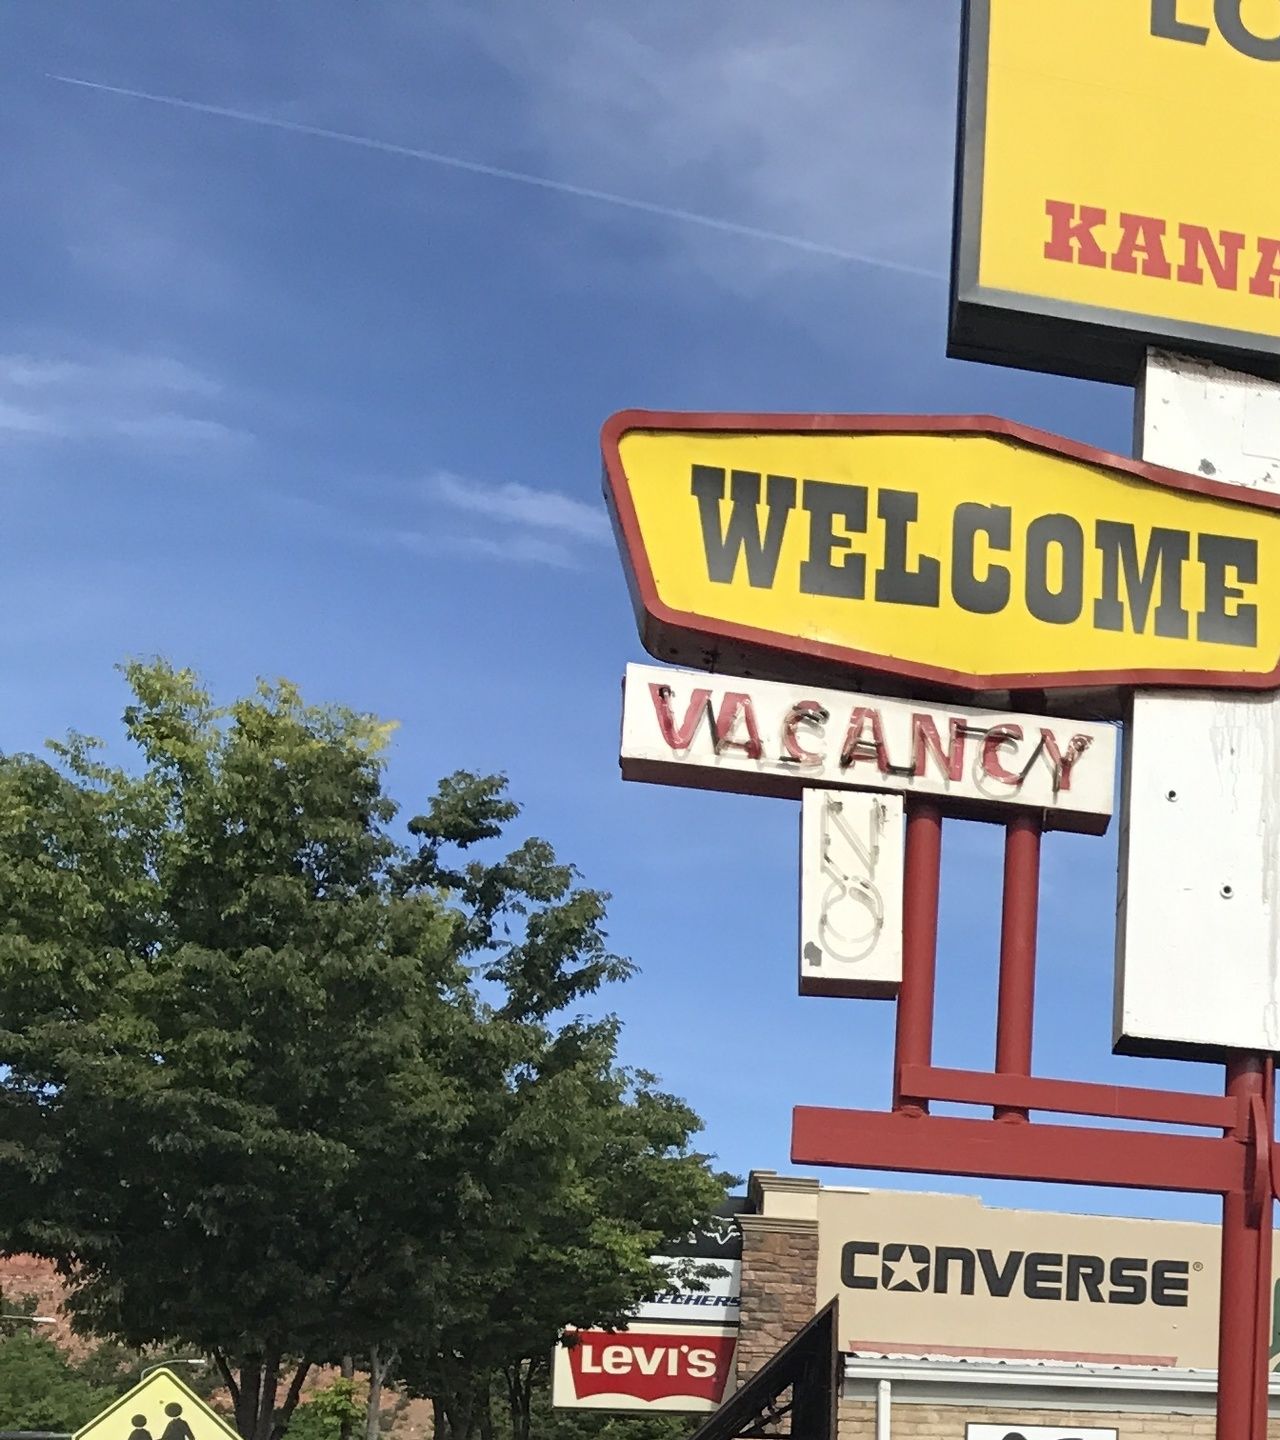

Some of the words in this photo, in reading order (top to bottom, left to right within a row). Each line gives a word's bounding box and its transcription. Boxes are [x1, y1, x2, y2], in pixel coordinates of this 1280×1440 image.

[691, 464, 1258, 647] WELCOME
[648, 682, 1095, 793] VACANCY
[841, 1240, 1190, 1307] CONVERSE
